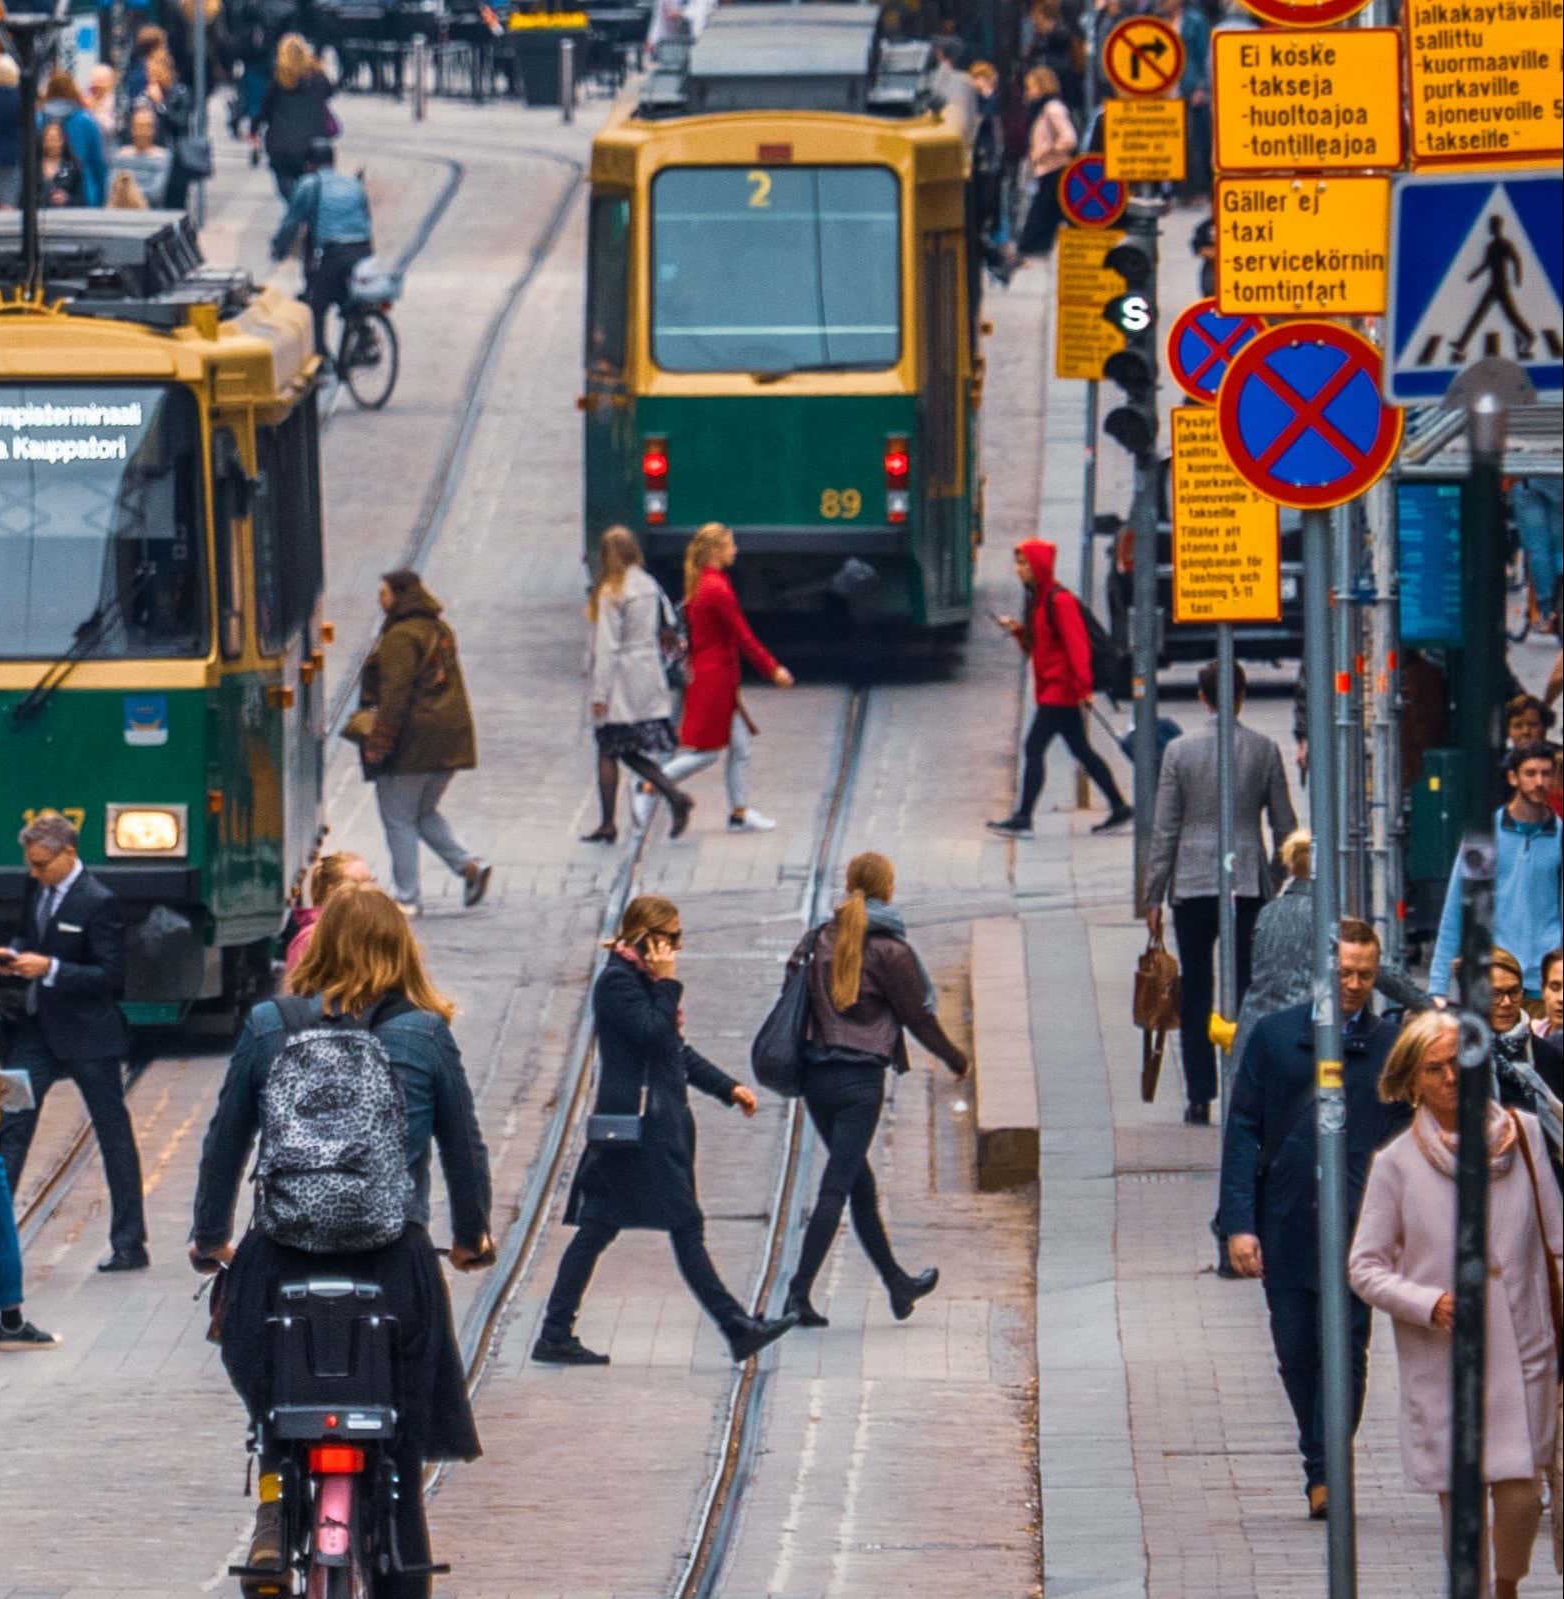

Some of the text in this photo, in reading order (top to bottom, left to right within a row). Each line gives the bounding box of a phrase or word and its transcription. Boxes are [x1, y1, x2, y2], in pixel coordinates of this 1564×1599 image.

[1415, 29, 1483, 50] sallittu
[1240, 44, 1337, 67] Ei koske
[1416, 49, 1550, 74] -kuormaaville
[1241, 74, 1334, 99] -takseja
[1423, 76, 1520, 103] purkaville
[1241, 103, 1368, 129] -huoltoajoa
[1425, 101, 1544, 128] ajoneuvoille
[1243, 132, 1377, 159] -tontilleajoa
[745, 170, 772, 208] 2
[1223, 188, 1320, 215] Gäller ej
[1224, 220, 1274, 242] -taxi
[1224, 279, 1347, 302] -tomtinfart
[12, 434, 127, 464] Kauppatori
[819, 488, 862, 519] 89
